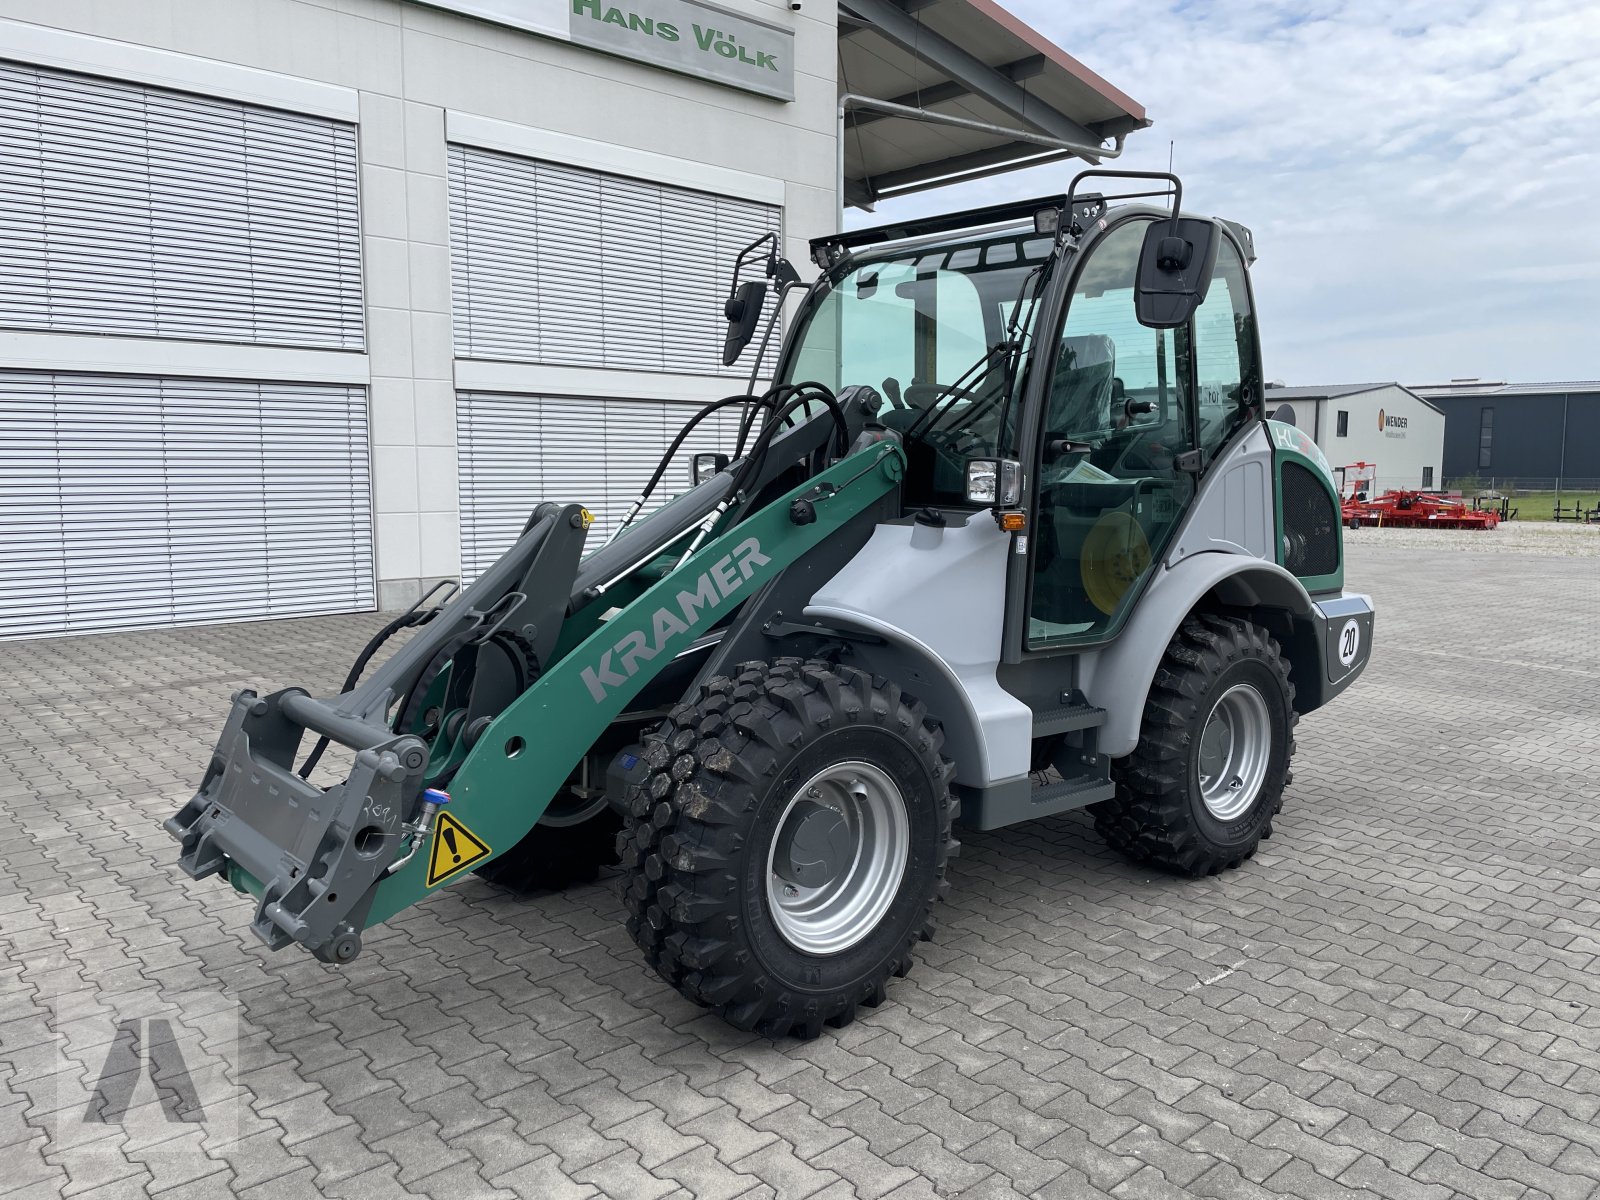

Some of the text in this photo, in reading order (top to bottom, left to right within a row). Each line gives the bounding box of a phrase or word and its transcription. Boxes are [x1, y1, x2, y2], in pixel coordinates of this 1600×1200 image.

[573, 0, 779, 73] HANS VÖLK
[1385, 415, 1408, 429] WENDER
[579, 537, 772, 704] KRAMER
[1342, 627, 1356, 658] 20
